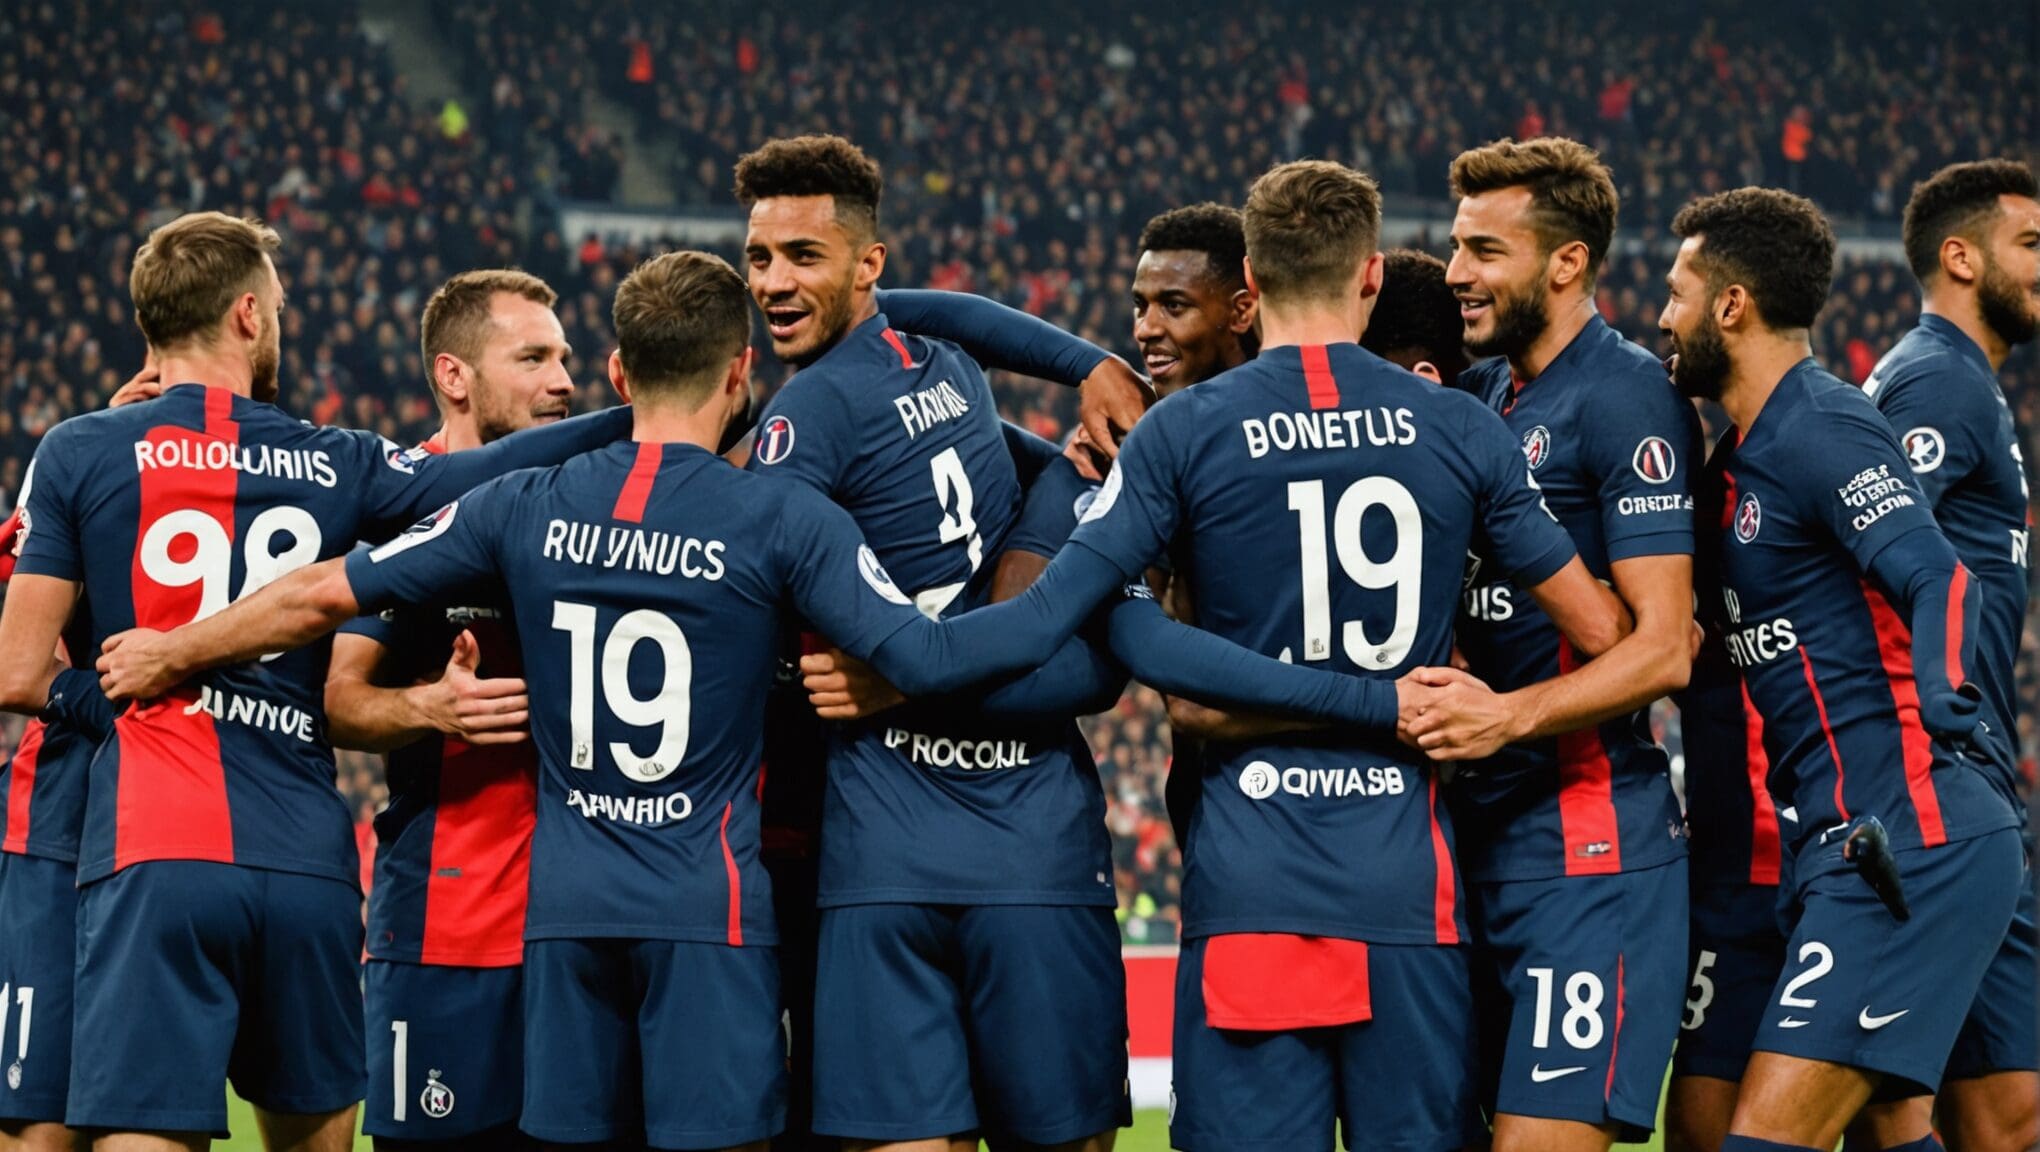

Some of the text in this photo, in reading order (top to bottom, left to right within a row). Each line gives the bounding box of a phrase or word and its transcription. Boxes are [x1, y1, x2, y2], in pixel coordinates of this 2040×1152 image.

[1287, 475, 1423, 671] 19
[551, 600, 692, 783] 19
[1527, 968, 1604, 1050] 18
[1779, 941, 1834, 1008] 2
[391, 1021, 407, 1121] 1
